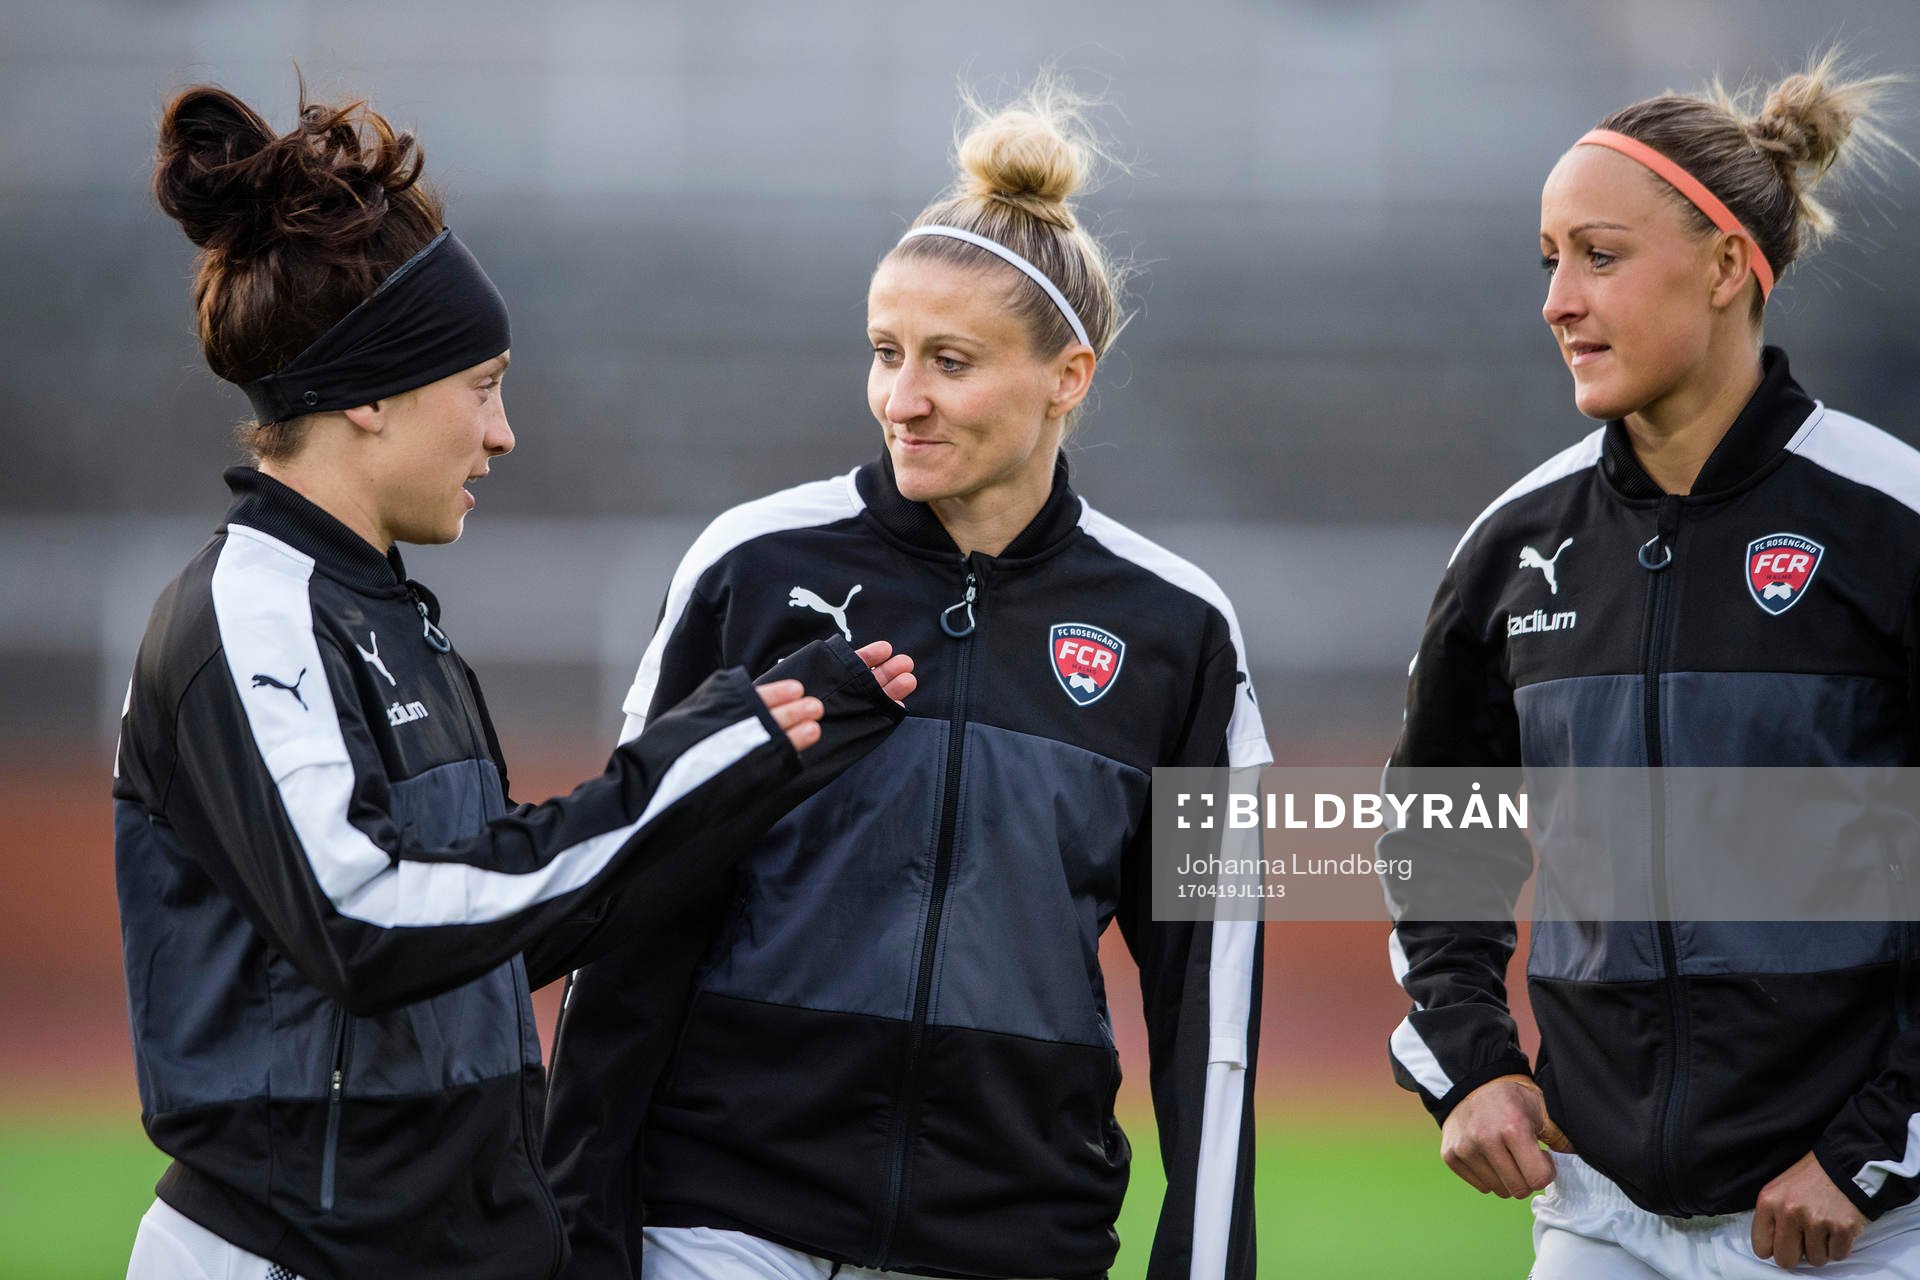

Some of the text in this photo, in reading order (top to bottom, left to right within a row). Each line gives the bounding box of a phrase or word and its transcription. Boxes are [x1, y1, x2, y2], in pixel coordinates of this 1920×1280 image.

[1754, 538, 1817, 553] FC ROSENGÅRD
[1754, 553, 1810, 574] FCR
[1057, 628, 1119, 650] FC ROSENGÅRD
[1059, 640, 1113, 672] FCR
